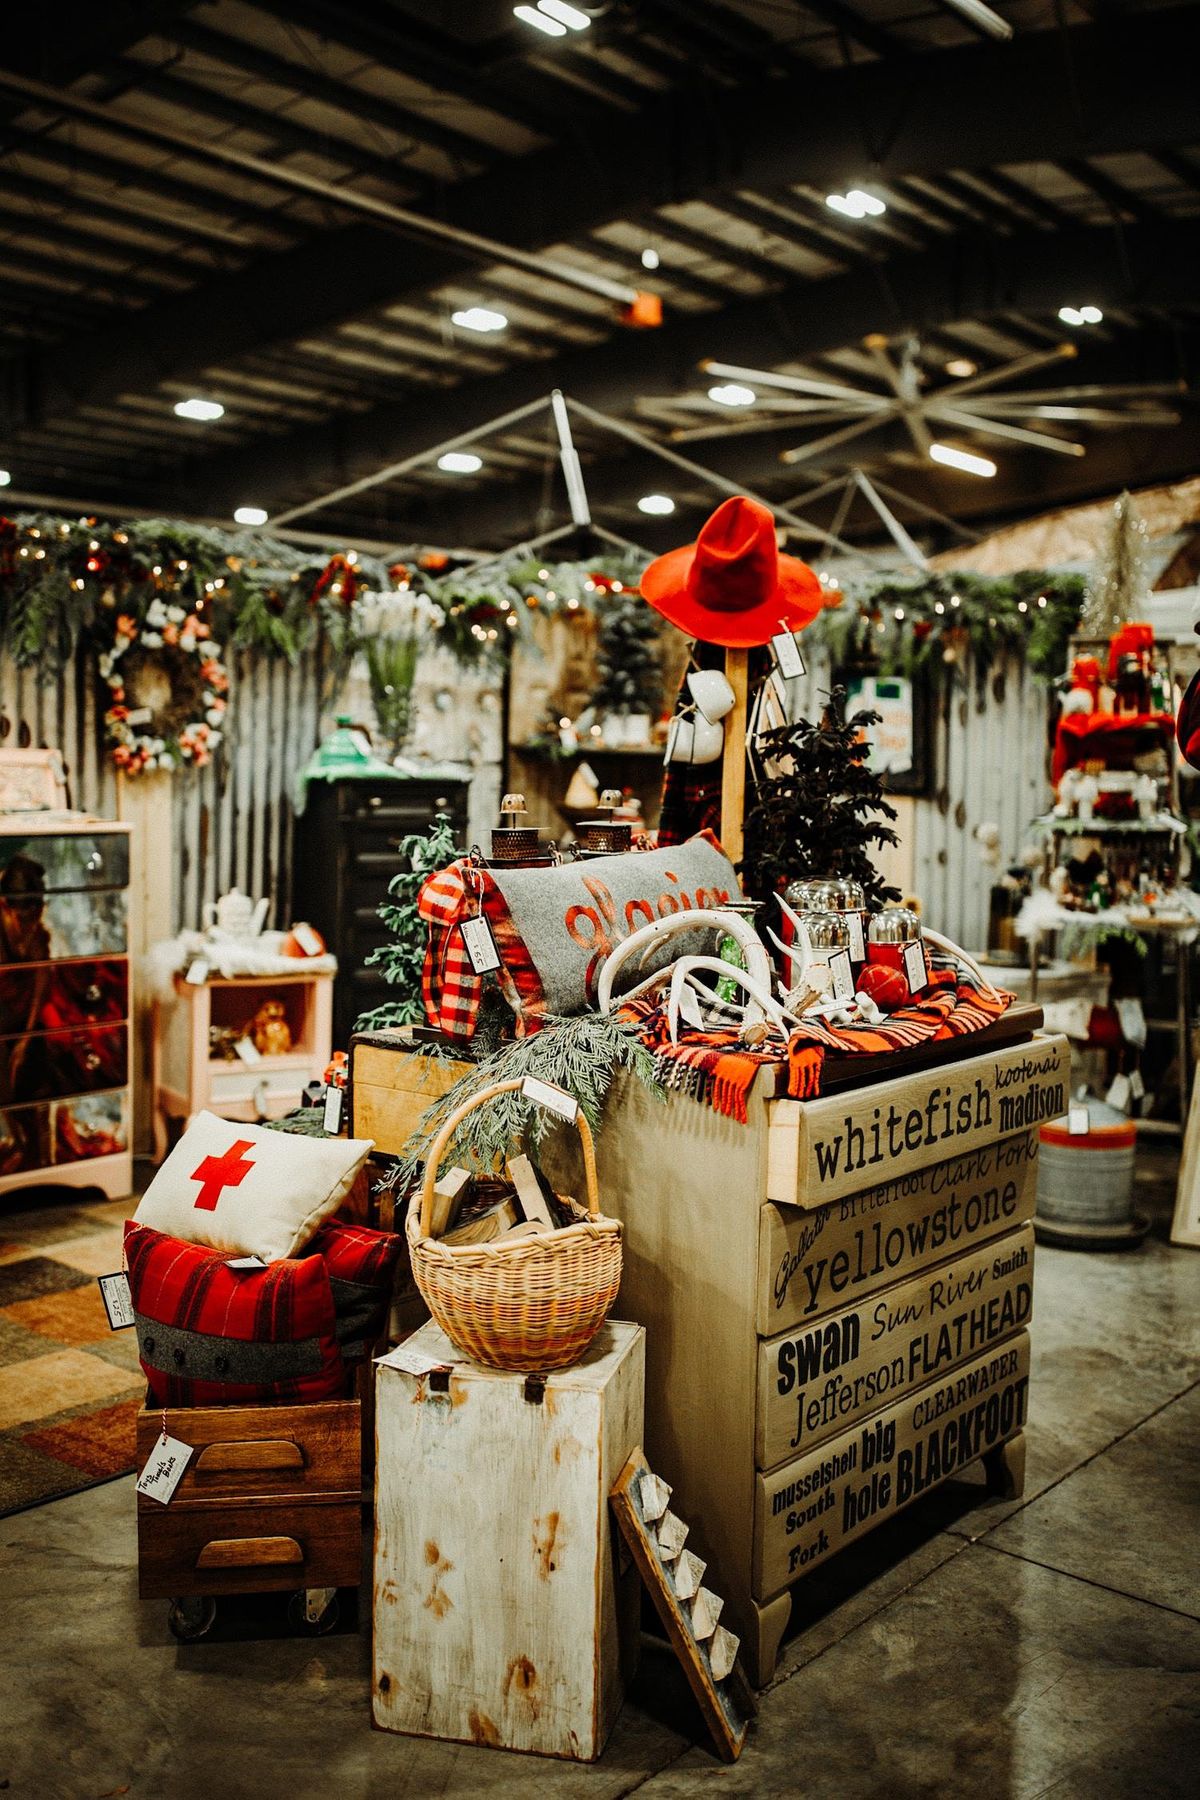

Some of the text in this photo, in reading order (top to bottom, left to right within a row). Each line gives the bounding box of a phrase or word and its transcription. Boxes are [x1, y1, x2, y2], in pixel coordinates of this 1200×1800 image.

[994, 1048, 1061, 1088] kootenai
[814, 1079, 992, 1182] whitefish
[999, 1082, 1063, 1133] madison
[930, 1150, 992, 1195] Clark
[803, 1180, 1017, 1315] yellowstone
[992, 1246, 1028, 1281] Smith
[871, 1266, 989, 1342] Sun River
[908, 1282, 1032, 1383] FLATHEAD
[777, 1313, 860, 1396] swan
[912, 1348, 1019, 1431] CLEARWATER
[790, 1356, 905, 1448] Jefferson
[772, 1441, 858, 1517] musselshell
[861, 1419, 897, 1474] big
[896, 1375, 1029, 1507] BLACKFOOT
[785, 1486, 836, 1536] South
[842, 1471, 892, 1535] hole
[788, 1528, 830, 1575] Fork
